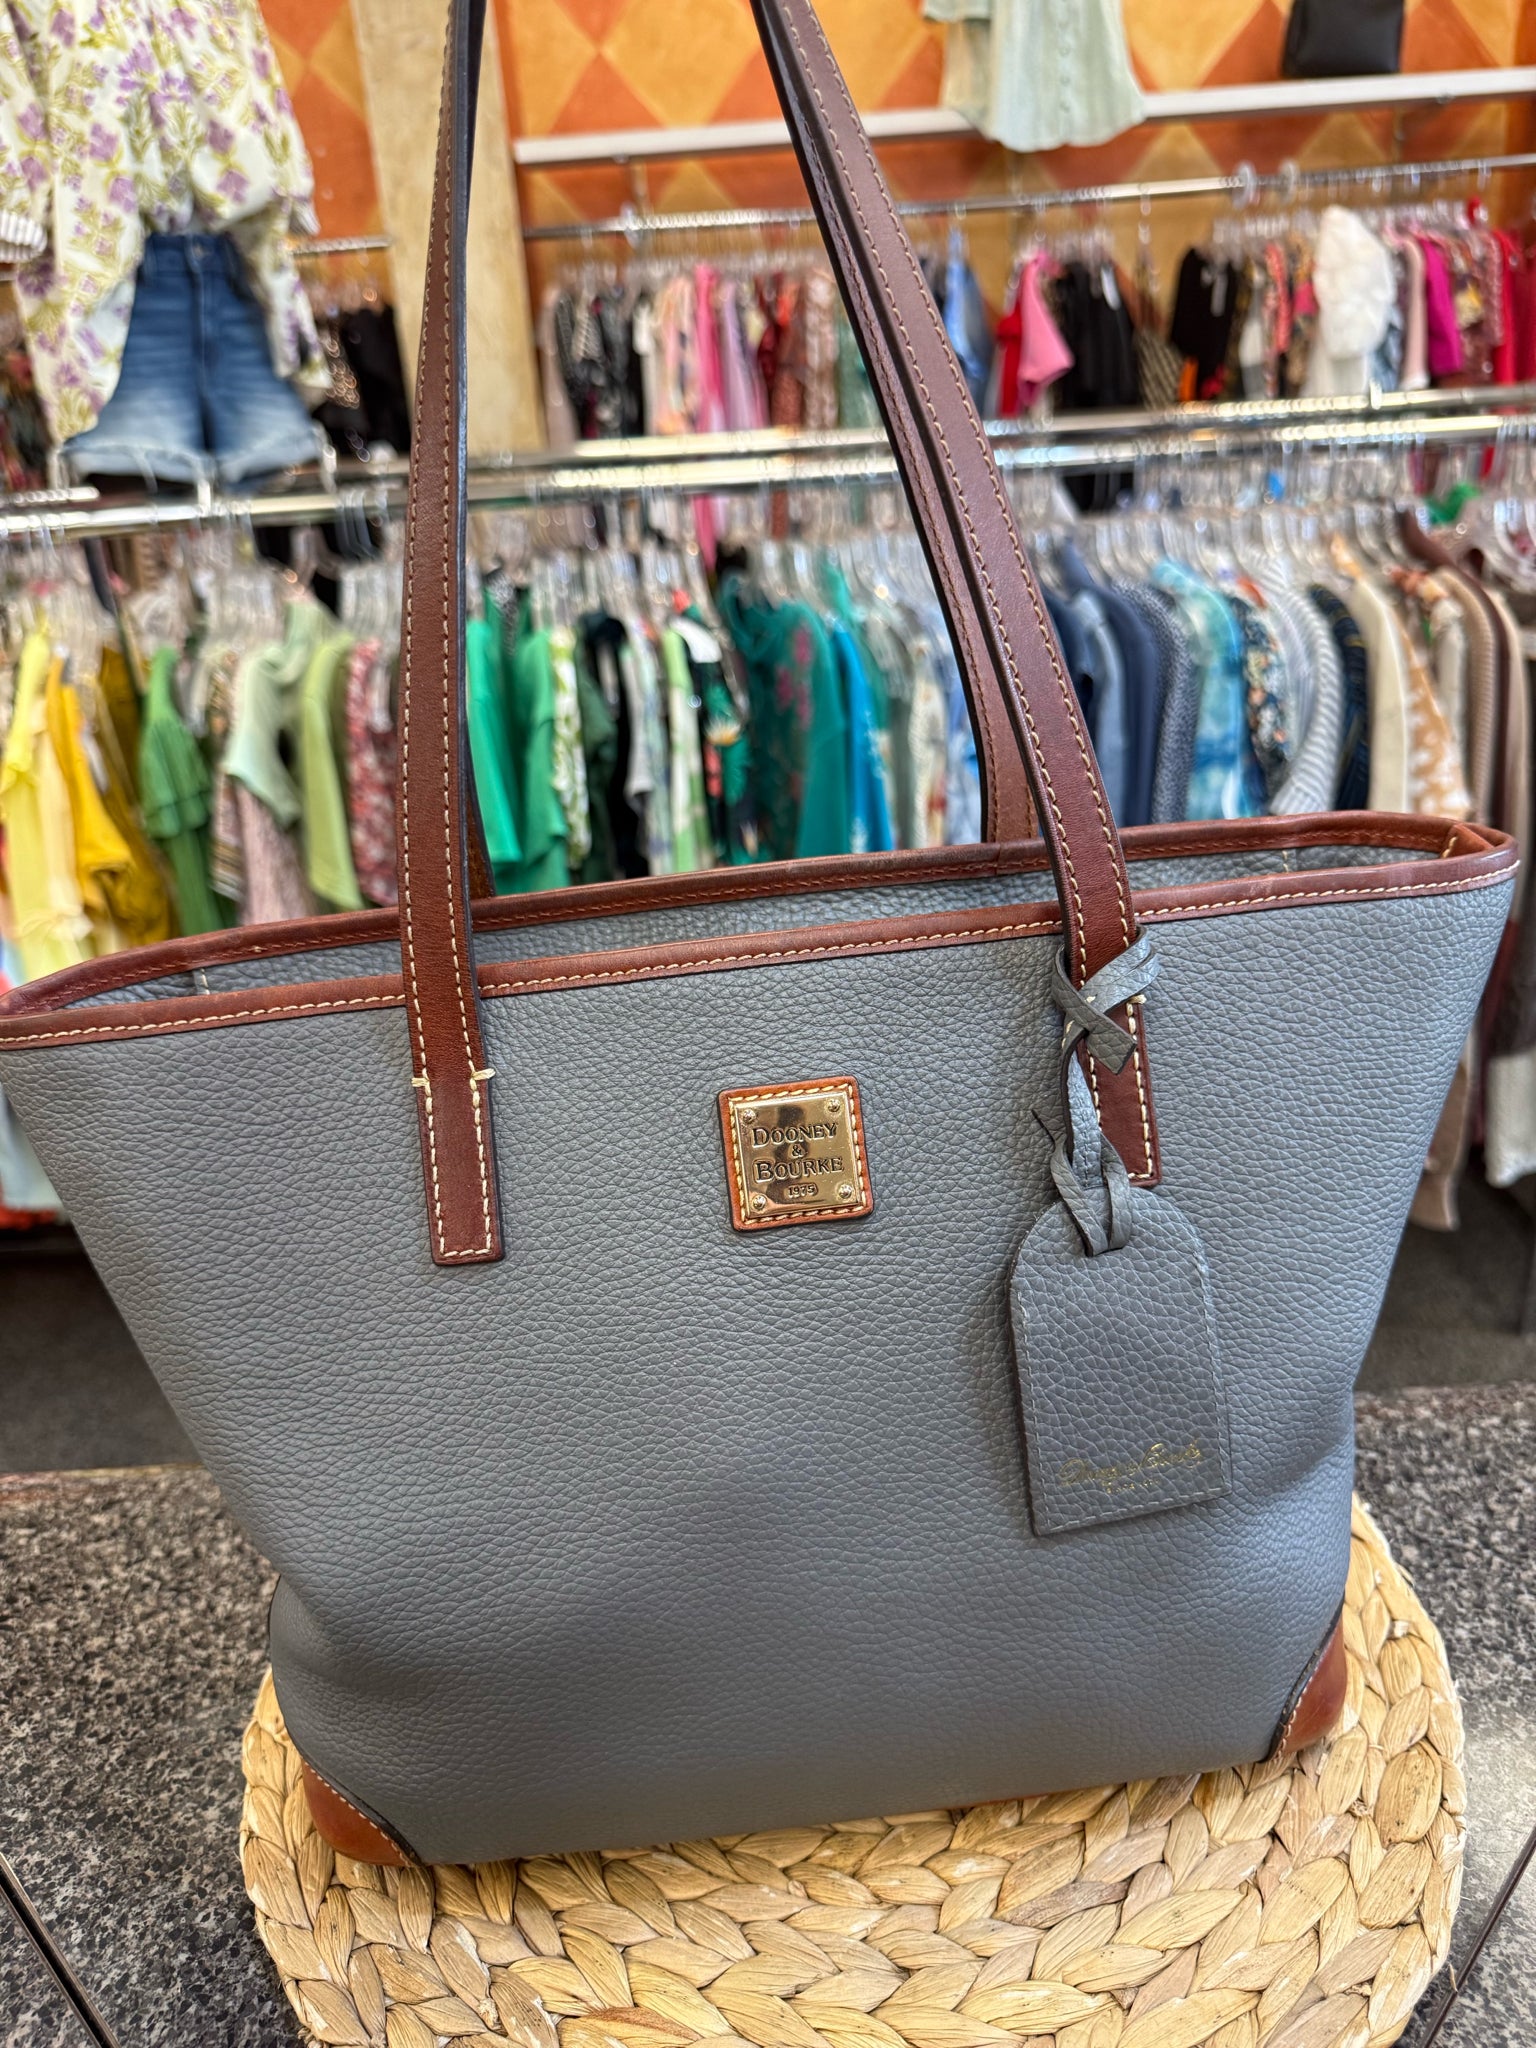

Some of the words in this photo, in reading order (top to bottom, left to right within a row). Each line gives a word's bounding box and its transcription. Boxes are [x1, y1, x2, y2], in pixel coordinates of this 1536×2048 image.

[752, 1122, 838, 1147] DOONEY
[791, 1144, 804, 1157] &
[755, 1157, 844, 1183] BOURKE
[788, 1184, 817, 1198] 1975
